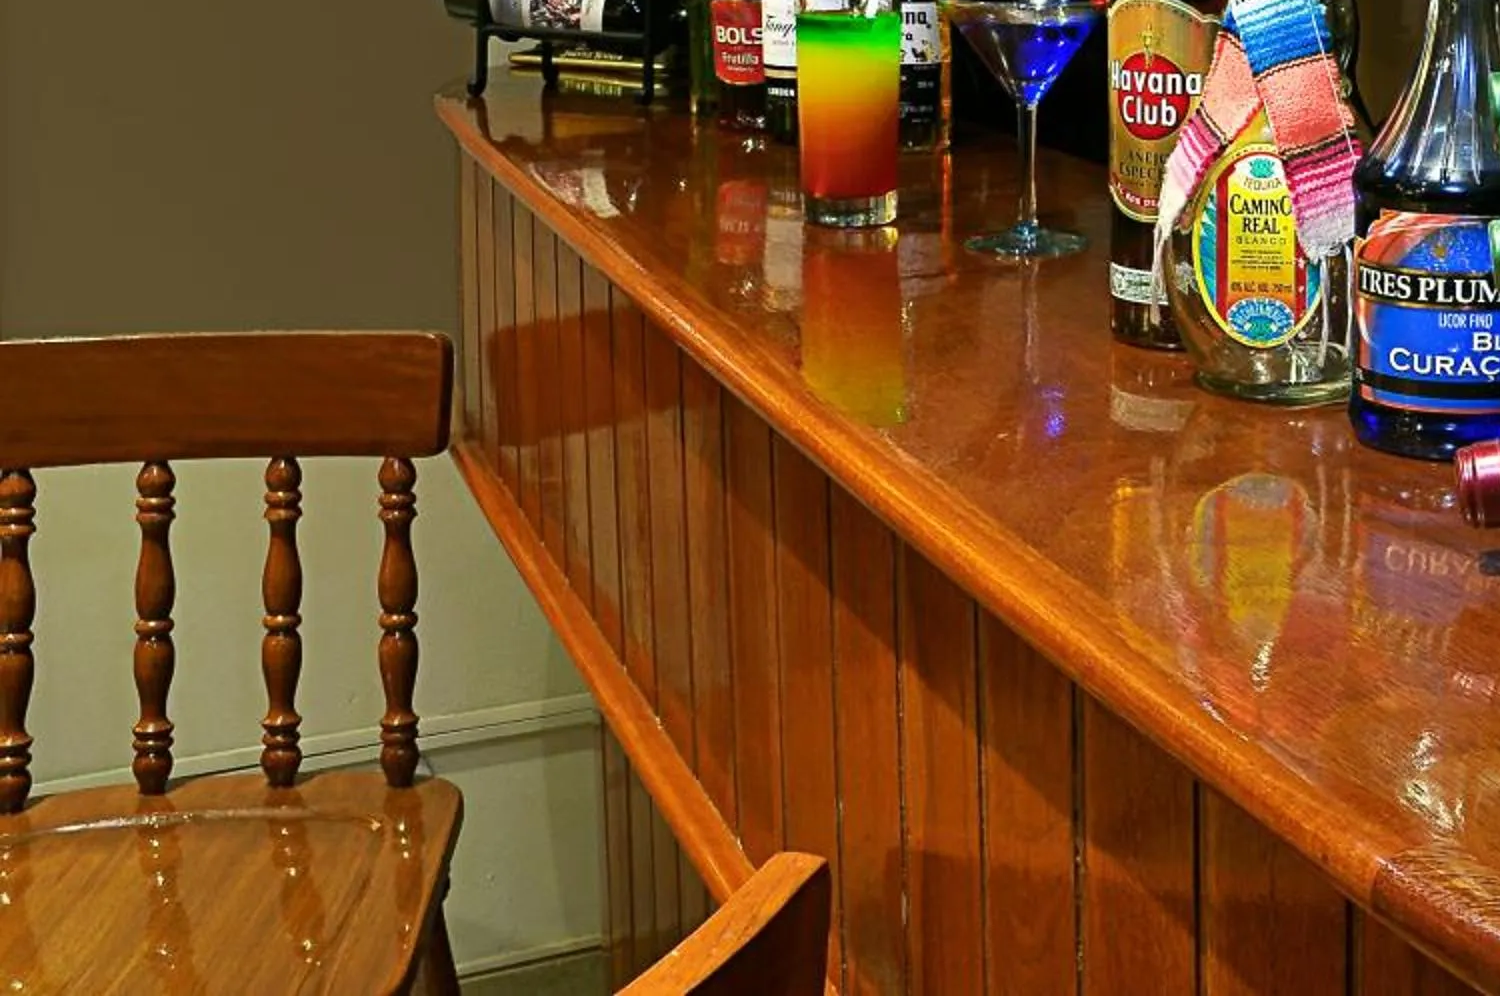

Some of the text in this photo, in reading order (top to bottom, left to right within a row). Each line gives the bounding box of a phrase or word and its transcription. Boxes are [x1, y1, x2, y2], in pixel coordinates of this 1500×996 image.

[715, 25, 763, 46] BOLS
[1110, 59, 1202, 95] Havana
[1121, 95, 1177, 127] Club
[1229, 194, 1292, 215] CAMINO
[1242, 217, 1280, 234] REAL
[1235, 235, 1287, 245] BLANCO
[1360, 266, 1412, 301] TRES
